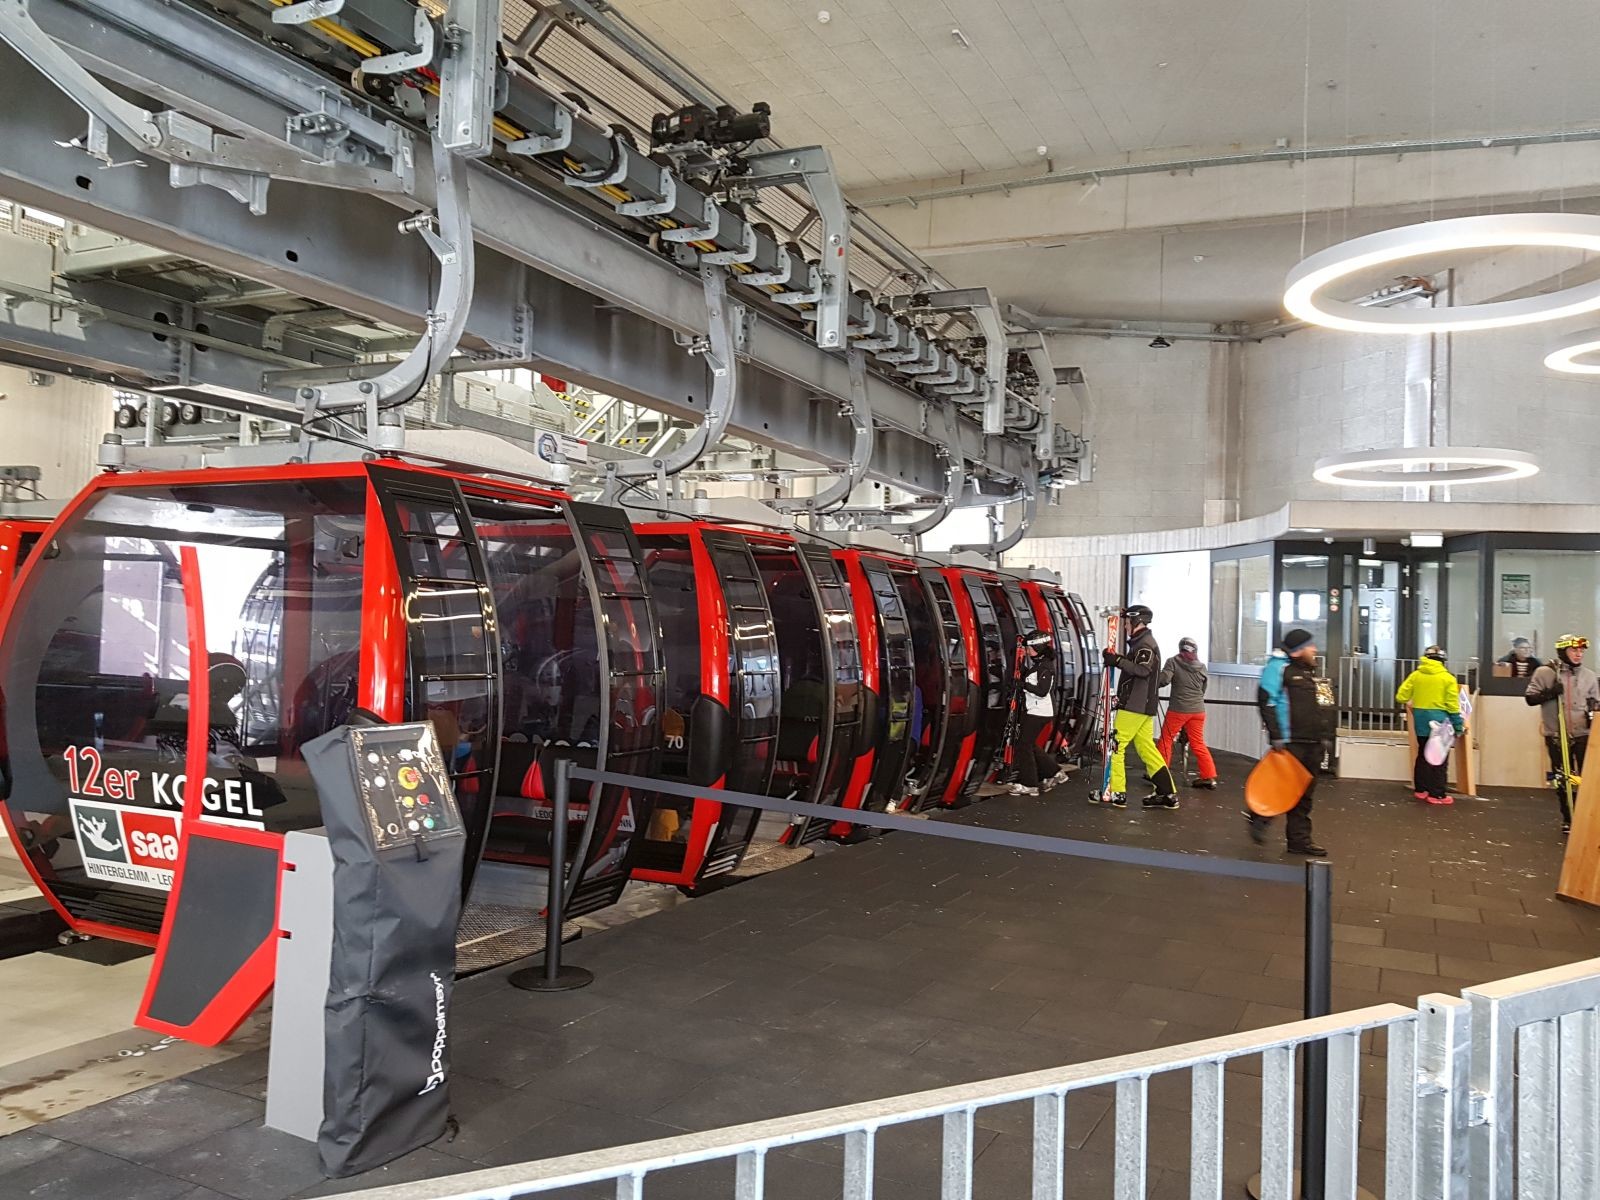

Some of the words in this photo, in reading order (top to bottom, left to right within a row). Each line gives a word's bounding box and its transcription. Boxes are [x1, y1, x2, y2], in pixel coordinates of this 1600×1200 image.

[666, 735, 684, 749] 70
[63, 744, 140, 801] 12er
[130, 830, 179, 862] saa
[87, 862, 150, 883] HINTERGLEMM
[430, 971, 447, 1074] Doppelmayr
